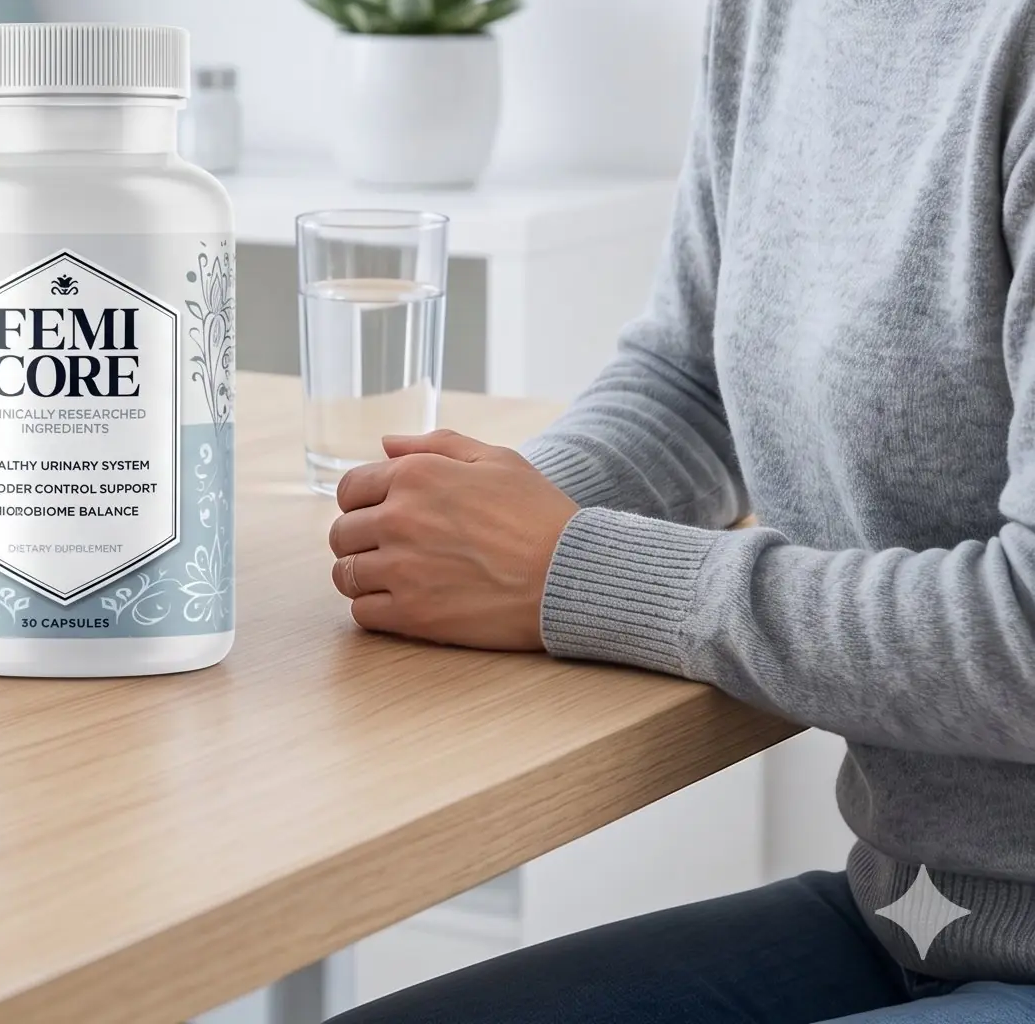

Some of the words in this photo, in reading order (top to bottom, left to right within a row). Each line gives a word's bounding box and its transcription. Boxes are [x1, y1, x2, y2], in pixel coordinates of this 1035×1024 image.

[58, 408, 147, 420] RESEARCHED
[21, 423, 109, 434] INGREDIENTS
[40, 460, 99, 471] URINARY
[101, 460, 150, 471] SYSTEM
[34, 483, 97, 494] CONTROL
[99, 483, 158, 494] SUPPORT
[79, 506, 139, 517] BALANCE
[21, 618, 38, 628] 30
[41, 618, 110, 628] CAPSULES
